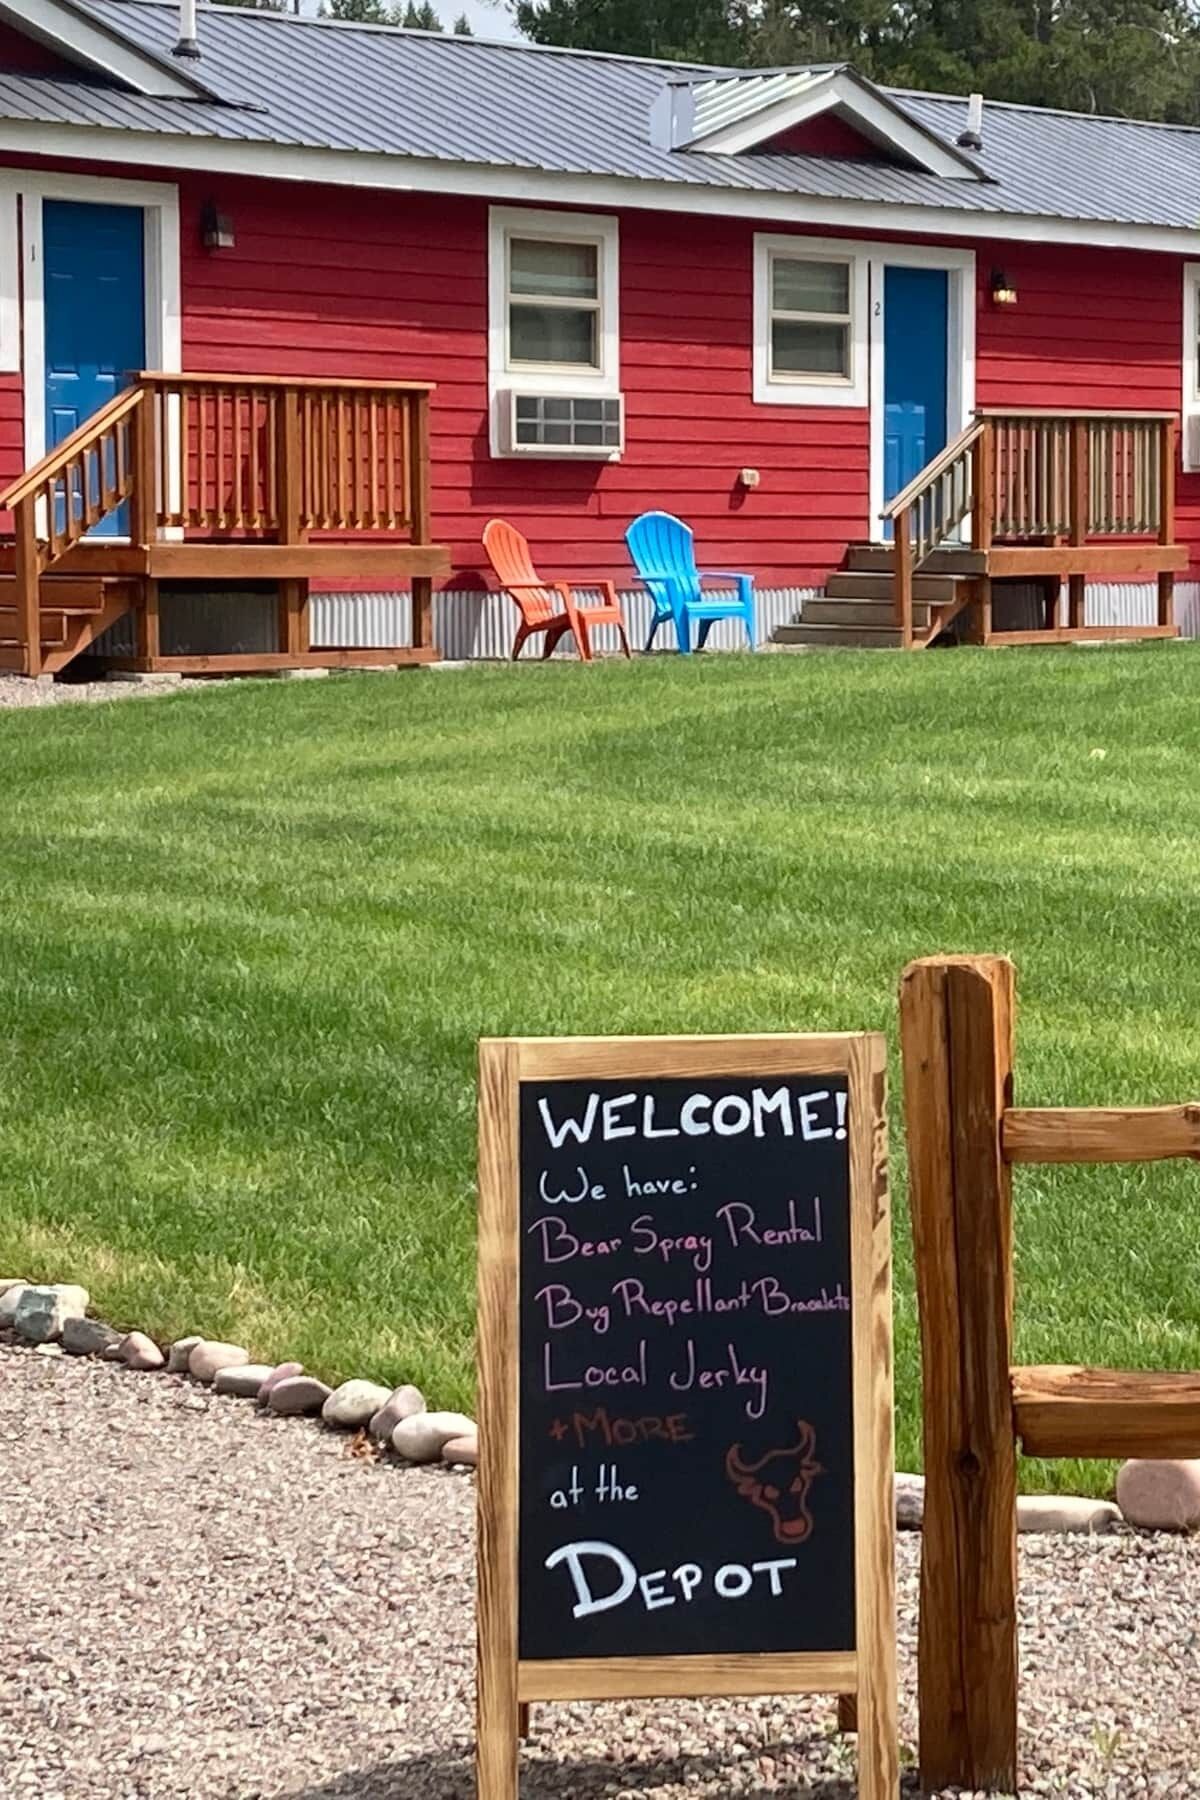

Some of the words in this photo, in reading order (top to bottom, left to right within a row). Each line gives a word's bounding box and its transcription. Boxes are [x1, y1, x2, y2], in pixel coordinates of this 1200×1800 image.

[874, 301, 881, 317] 2
[537, 1086, 848, 1149] WELCOME!
[538, 1166, 607, 1203] We
[623, 1164, 700, 1198] have:
[527, 1216, 623, 1263] Bear
[629, 1214, 713, 1272] Spray
[715, 1196, 823, 1249] Rental
[533, 1284, 611, 1334] Bug
[611, 1277, 751, 1326] Repellant
[543, 1339, 648, 1392] Local
[669, 1339, 768, 1419] Jerky
[549, 1464, 585, 1508] at
[594, 1463, 640, 1502] the
[545, 1541, 797, 1619] DEPOT
